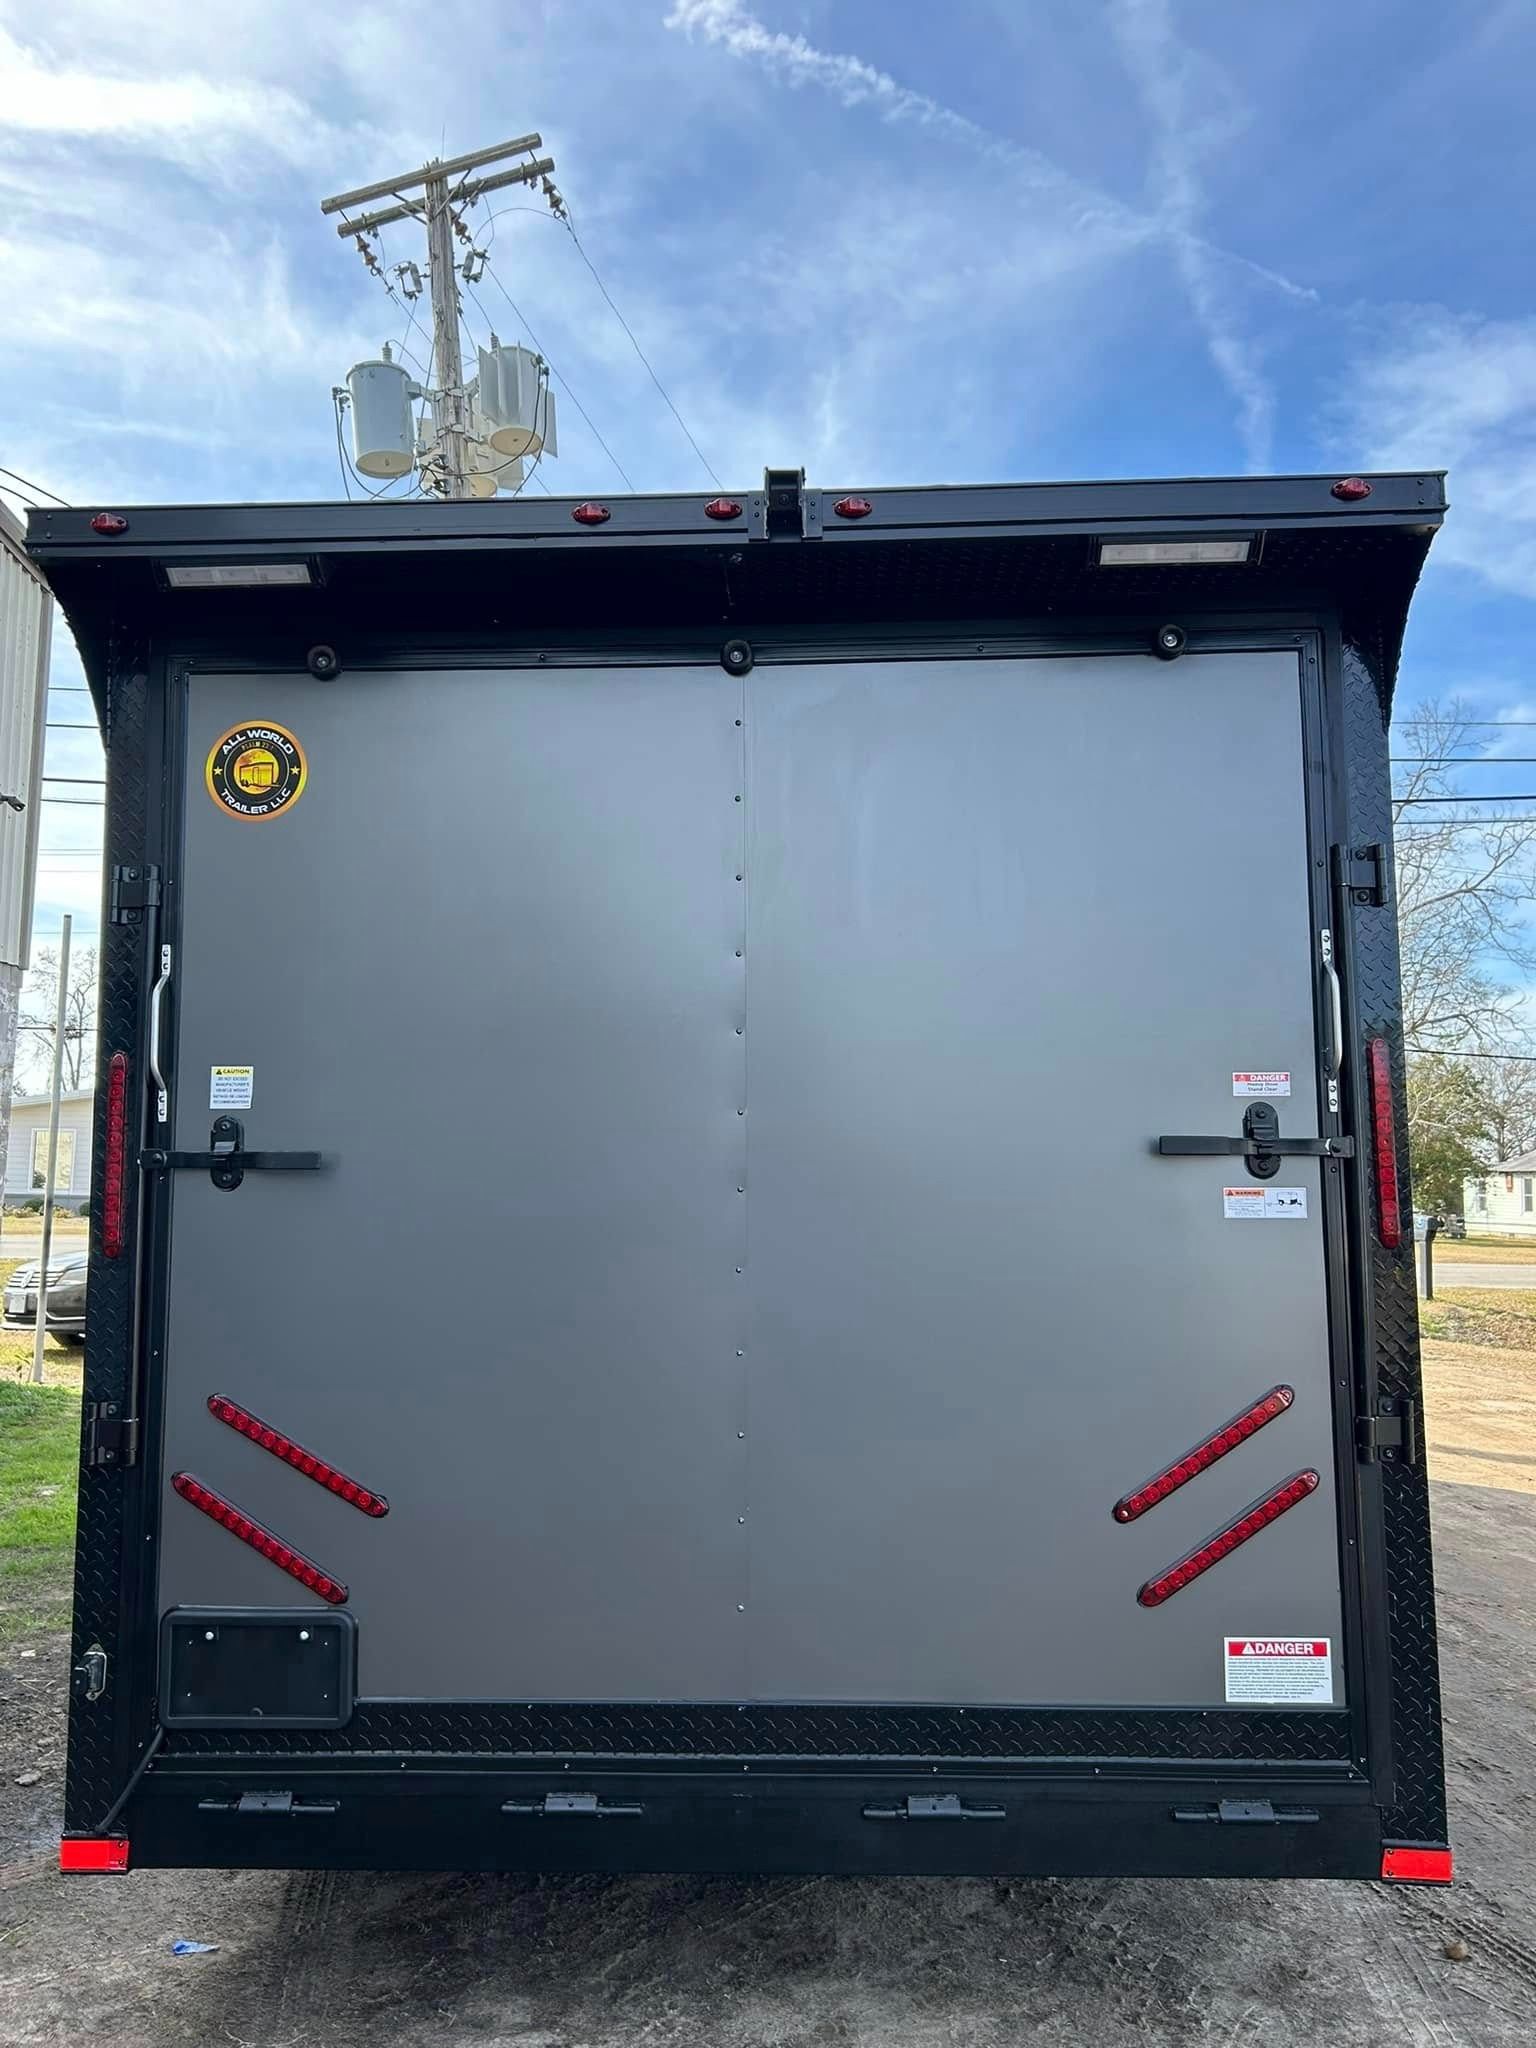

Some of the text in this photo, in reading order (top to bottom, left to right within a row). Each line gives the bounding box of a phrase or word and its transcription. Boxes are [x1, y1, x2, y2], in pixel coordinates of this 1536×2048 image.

[222, 733, 246, 755] ALL
[246, 729, 294, 755] WORLD
[221, 787, 291, 814] TRAILER LLC
[1255, 1642, 1314, 1655] DANGER
